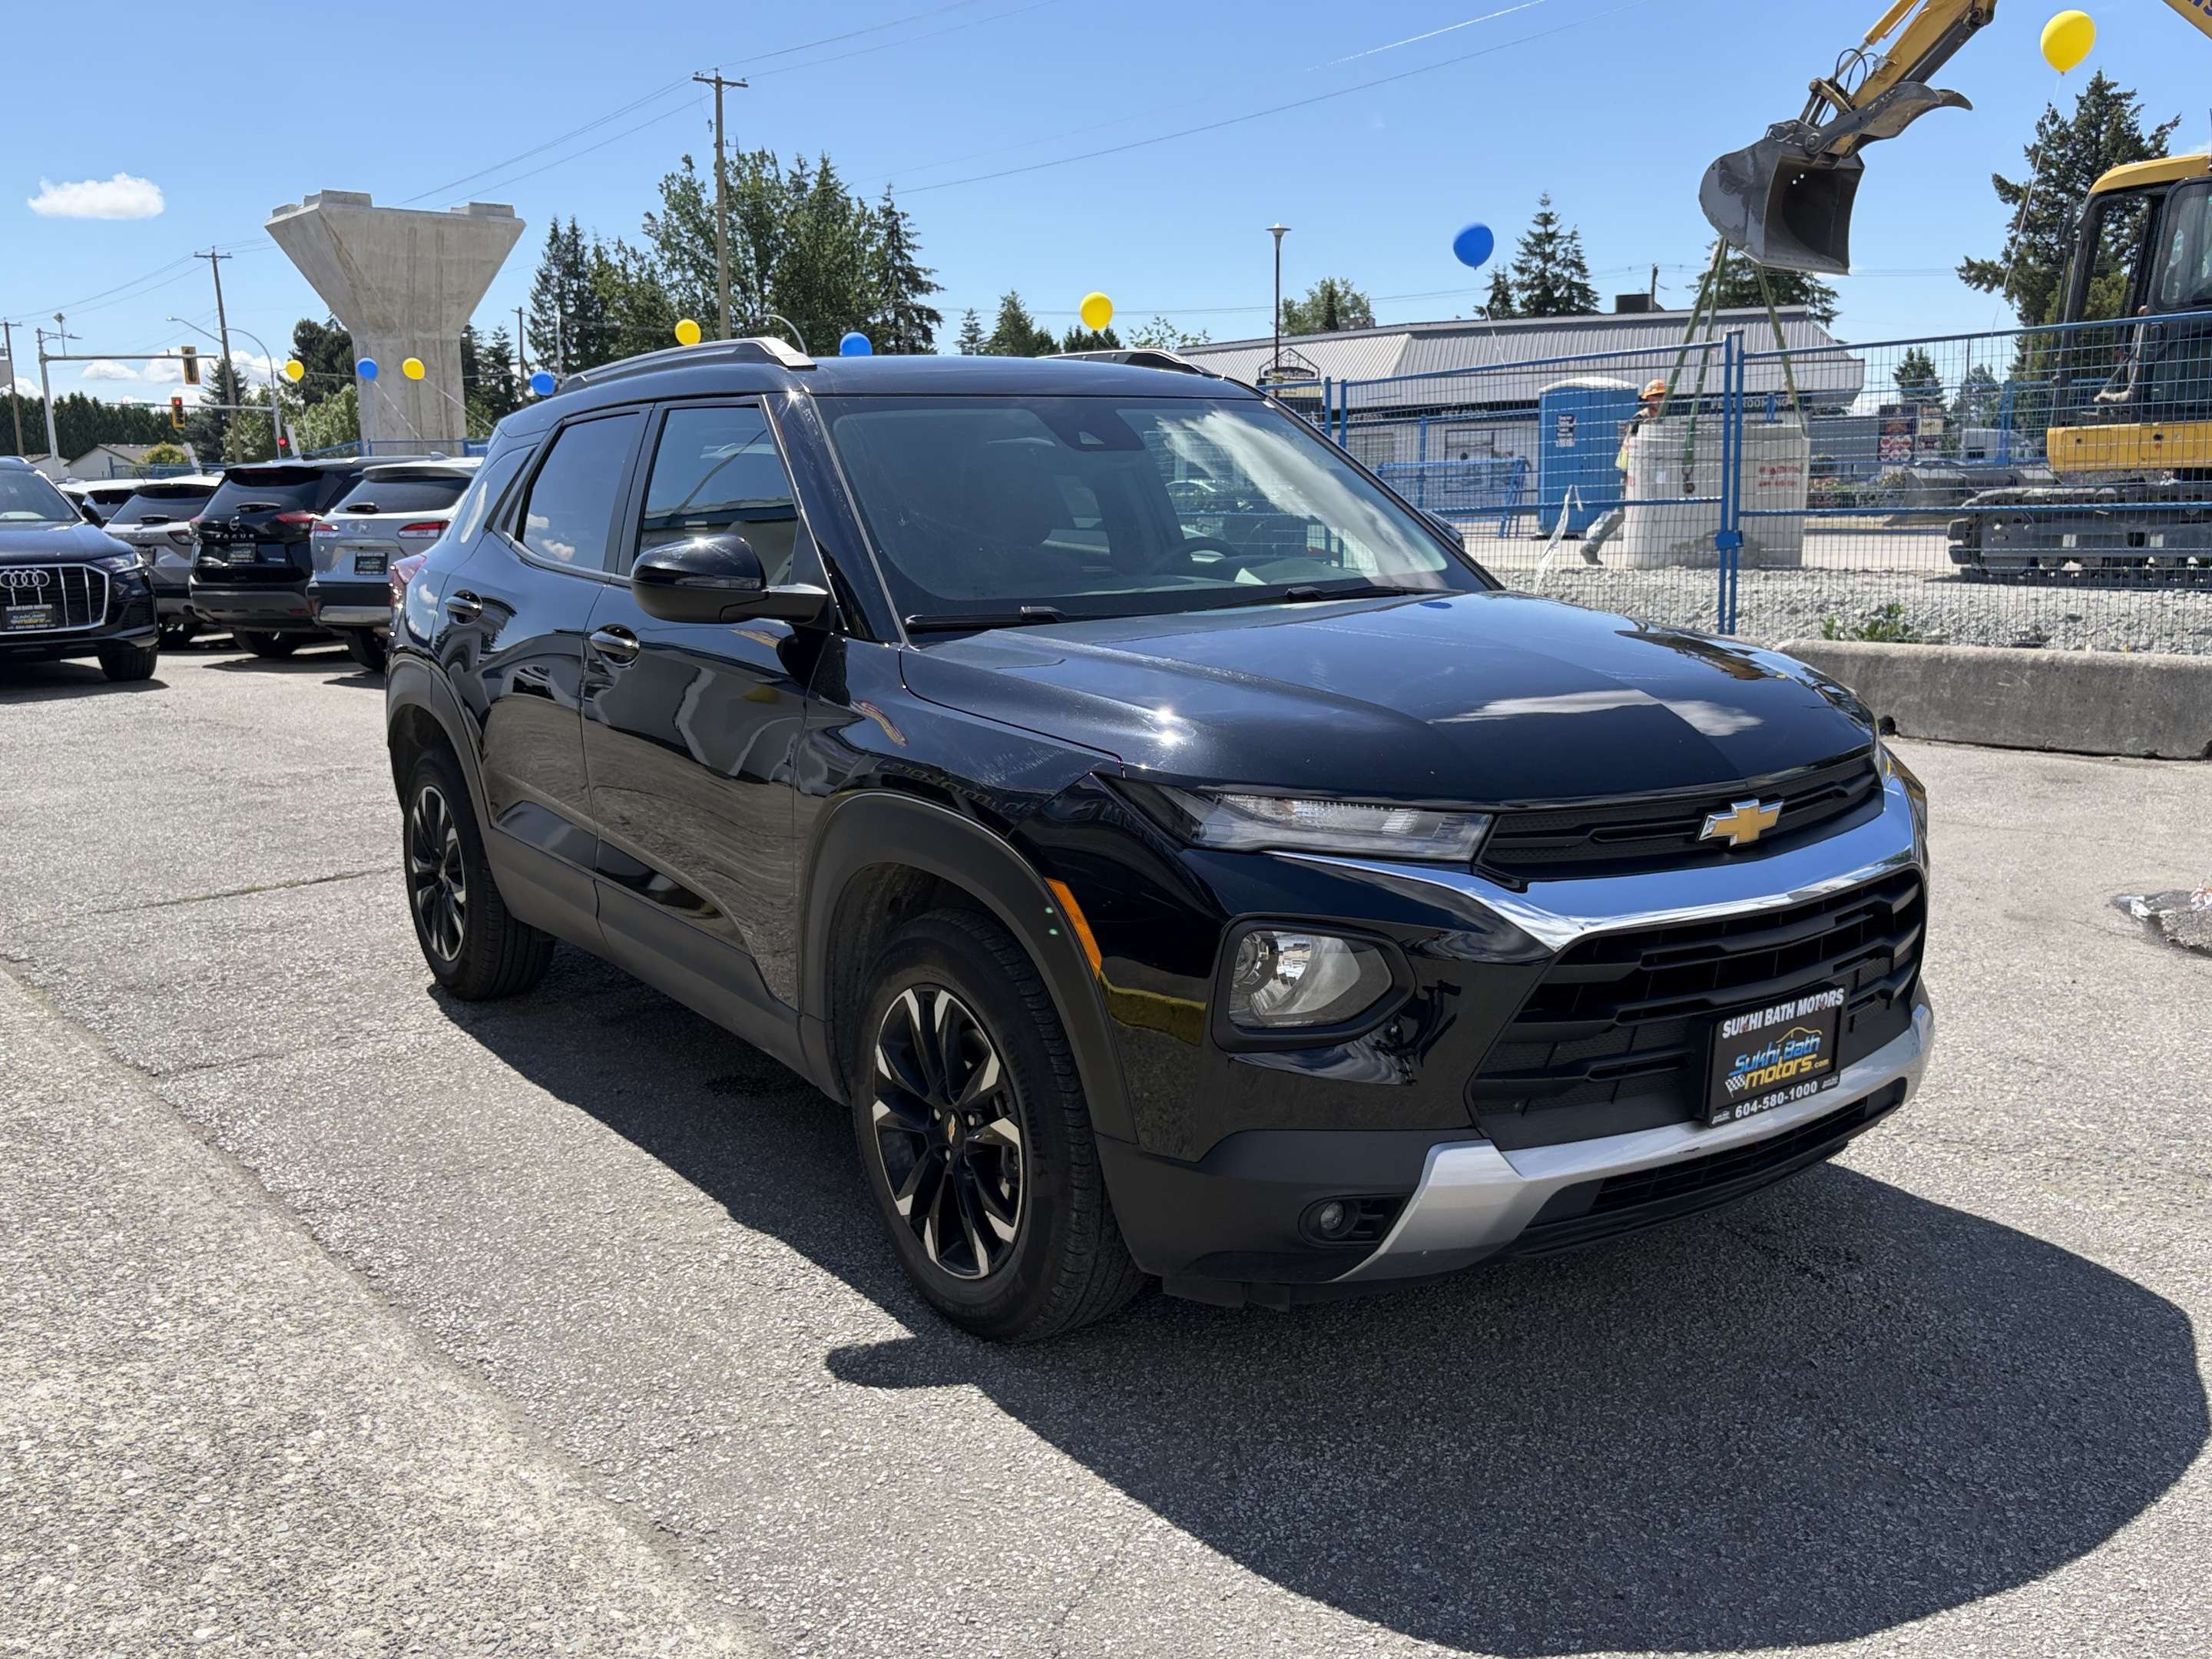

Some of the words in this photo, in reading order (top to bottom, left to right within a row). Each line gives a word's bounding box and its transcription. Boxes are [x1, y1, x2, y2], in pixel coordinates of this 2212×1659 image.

[1722, 1011, 1763, 1038] SUKHI
[1764, 1002, 1796, 1026] BATH
[1796, 988, 1845, 1017] MOTORS
[1728, 1041, 1782, 1076] Sukhi
[1783, 1035, 1821, 1060] Bath
[1734, 1080, 1818, 1119] 604-580-1000
